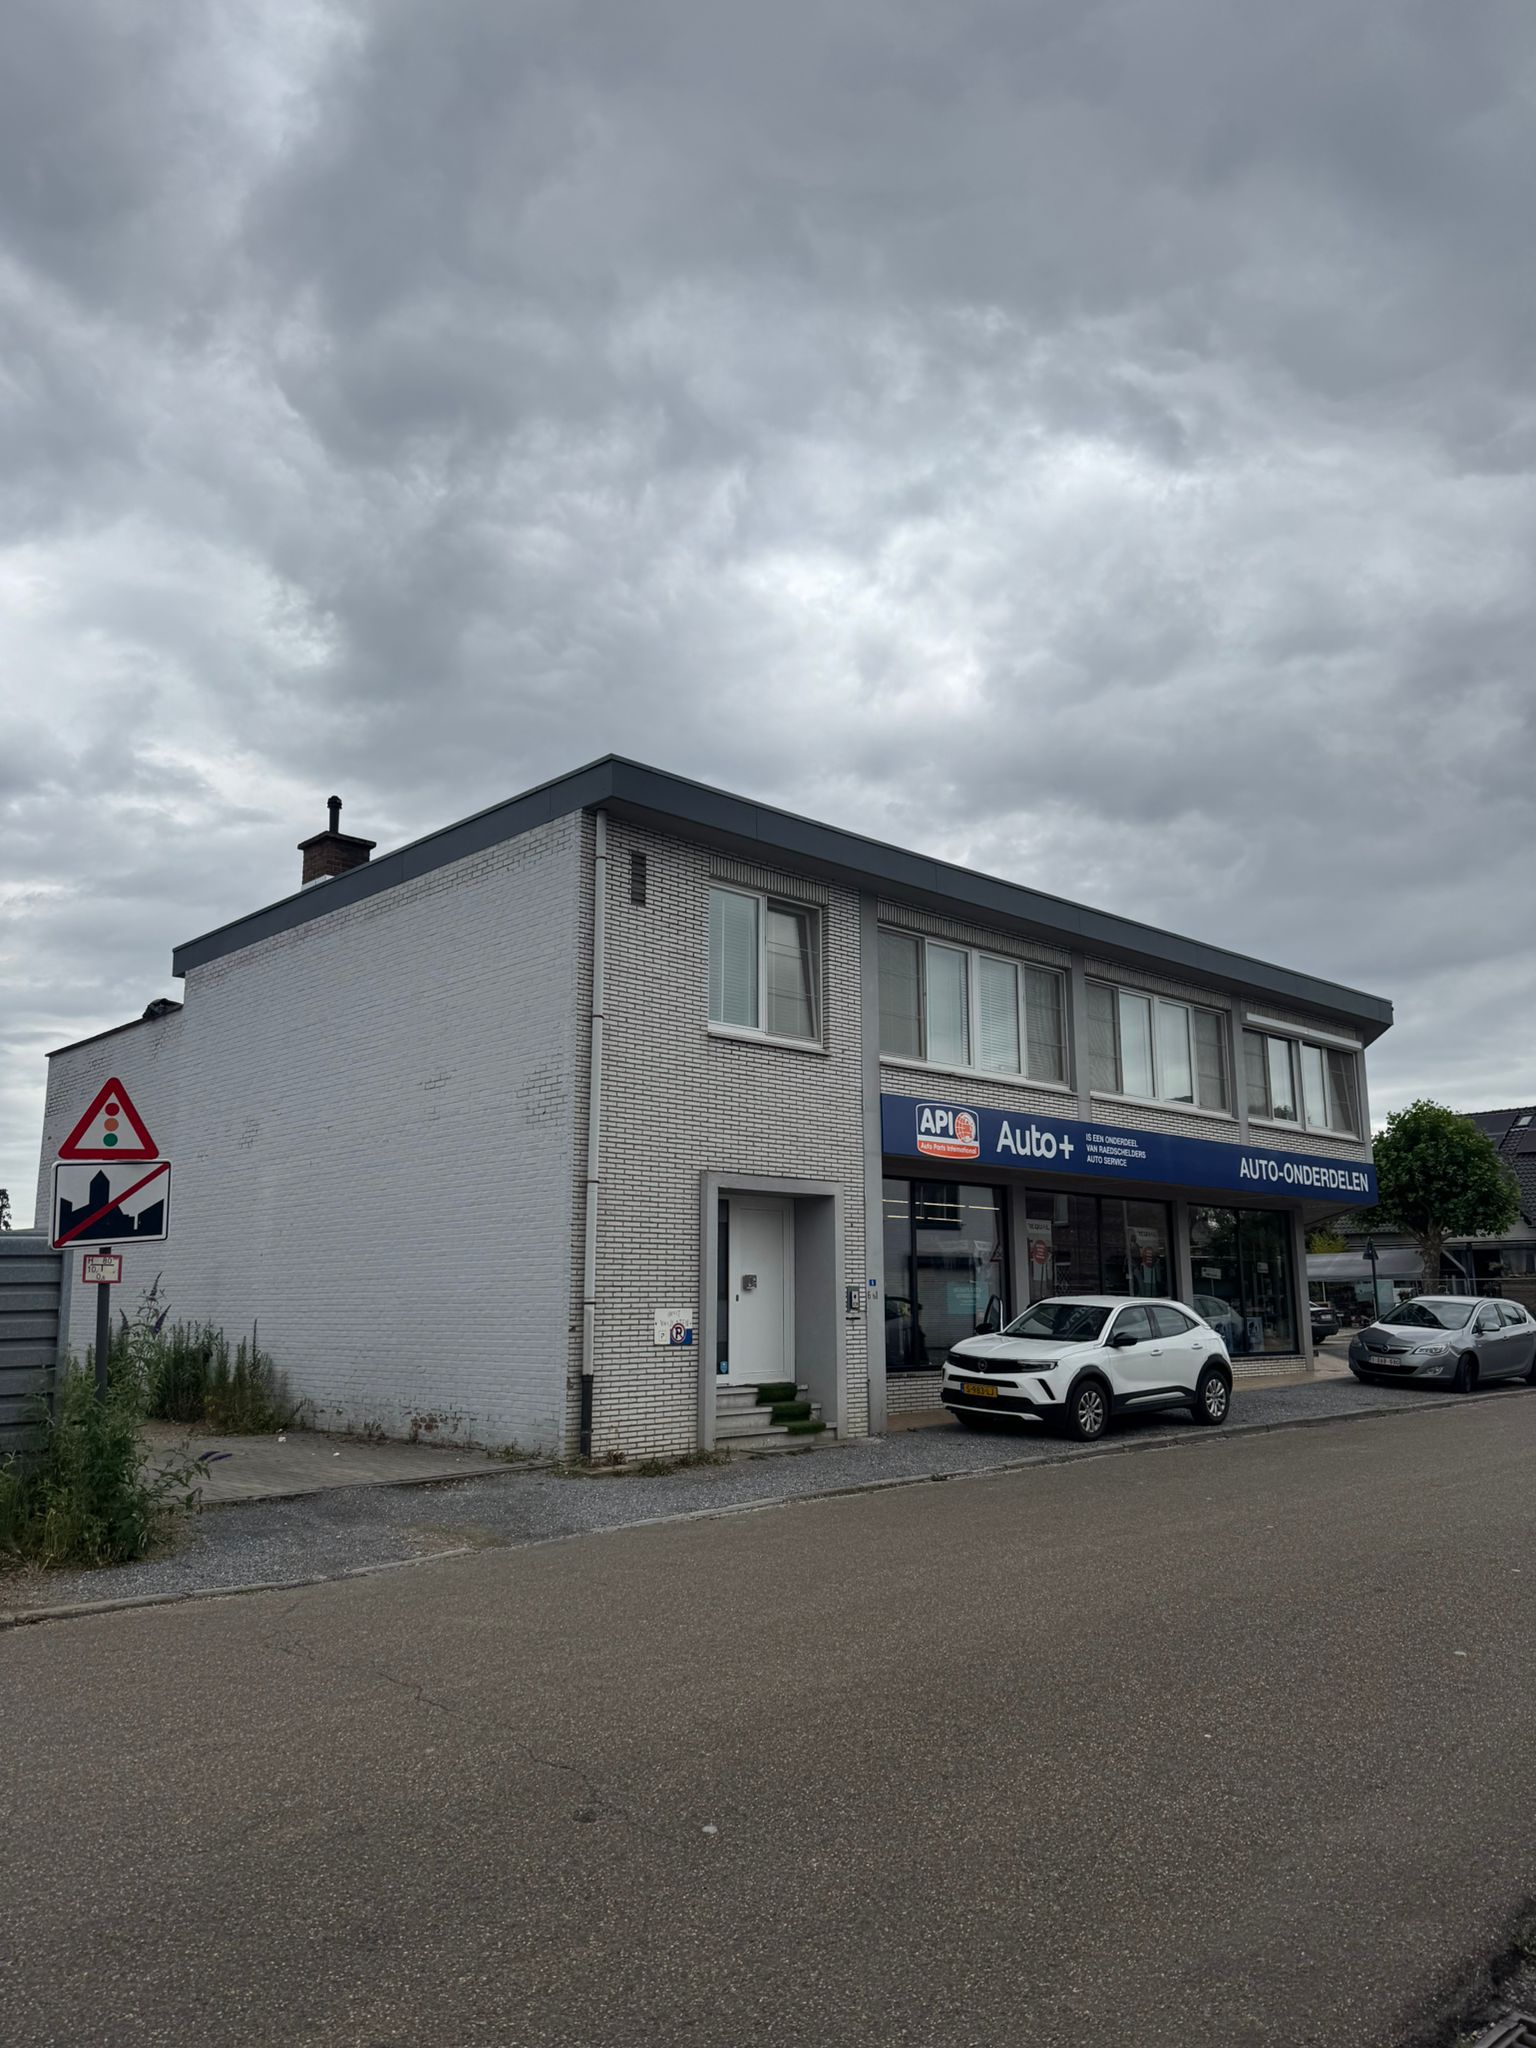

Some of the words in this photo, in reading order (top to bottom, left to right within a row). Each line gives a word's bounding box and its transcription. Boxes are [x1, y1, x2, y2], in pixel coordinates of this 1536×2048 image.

[920, 1108, 954, 1136] API
[921, 1142, 933, 1150] Auto
[1085, 1133, 1092, 1142] IS
[1093, 1134, 1104, 1143] EEN
[1105, 1136, 1138, 1148] ONDERDEEL
[1086, 1144, 1098, 1153] VAN
[1099, 1145, 1146, 1159] RAEDSCHELDERS
[1087, 1155, 1102, 1164] AUTO
[1103, 1156, 1127, 1167] SERVICE
[1240, 1157, 1369, 1192] AUTO-ONDERDELEN
